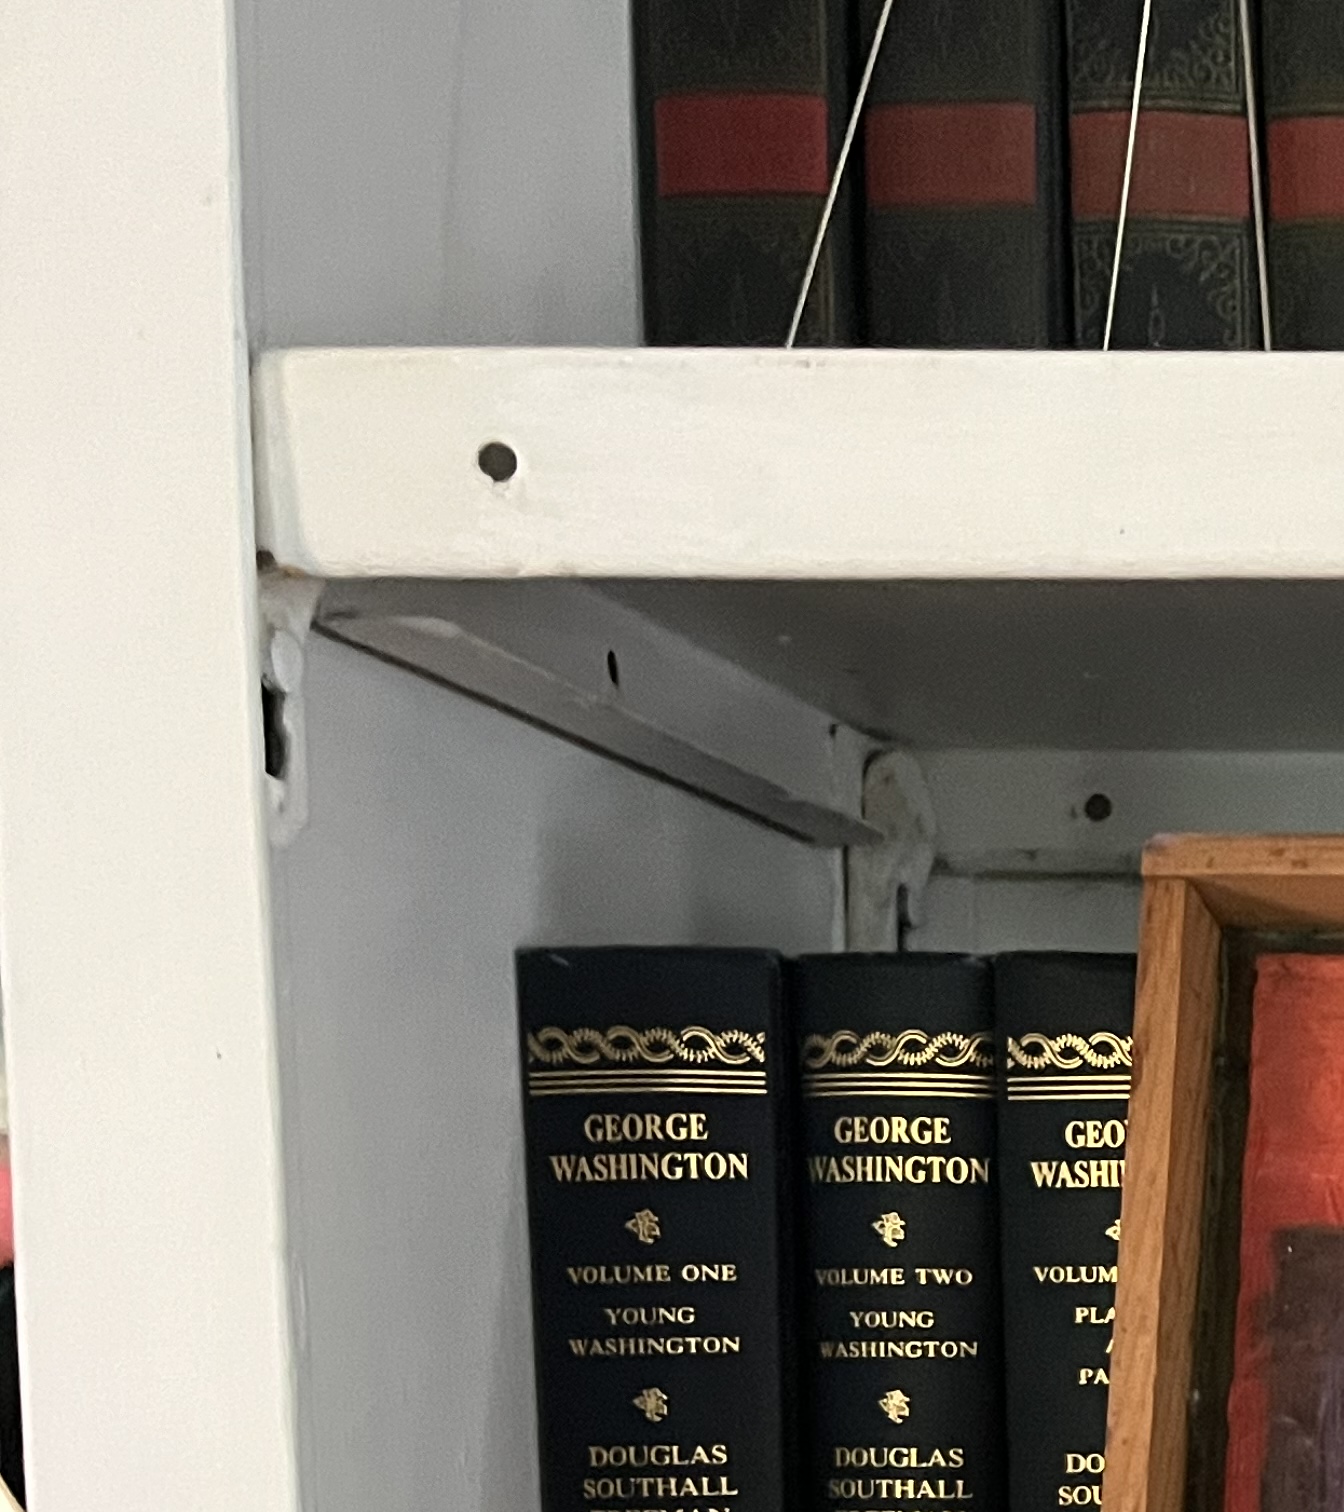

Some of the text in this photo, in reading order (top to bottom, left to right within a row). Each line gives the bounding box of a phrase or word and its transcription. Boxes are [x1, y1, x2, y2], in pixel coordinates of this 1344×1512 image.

[584, 1113, 709, 1143] GEORGE
[834, 1115, 952, 1145] GEORGE
[1064, 1119, 1127, 1149] GEO
[550, 1152, 749, 1183] WASHINGTON
[808, 1154, 990, 1184] WASHINGTON
[1030, 1158, 1126, 1188] WASHI
[567, 1264, 738, 1284] VOLUME ONE
[815, 1266, 973, 1286] VOLUME TWO
[1033, 1266, 1118, 1284] VOLUM
[604, 1306, 696, 1326] YOUNG
[849, 1311, 935, 1329] YOUNG
[569, 1336, 741, 1357] WASHINGTON
[820, 1340, 978, 1359] WASHINGTON
[588, 1444, 728, 1468] DOUGLAS
[835, 1447, 964, 1469] DOUGLAS
[583, 1475, 739, 1500] SOUTHALL
[828, 1477, 974, 1500] SOUTHALL
